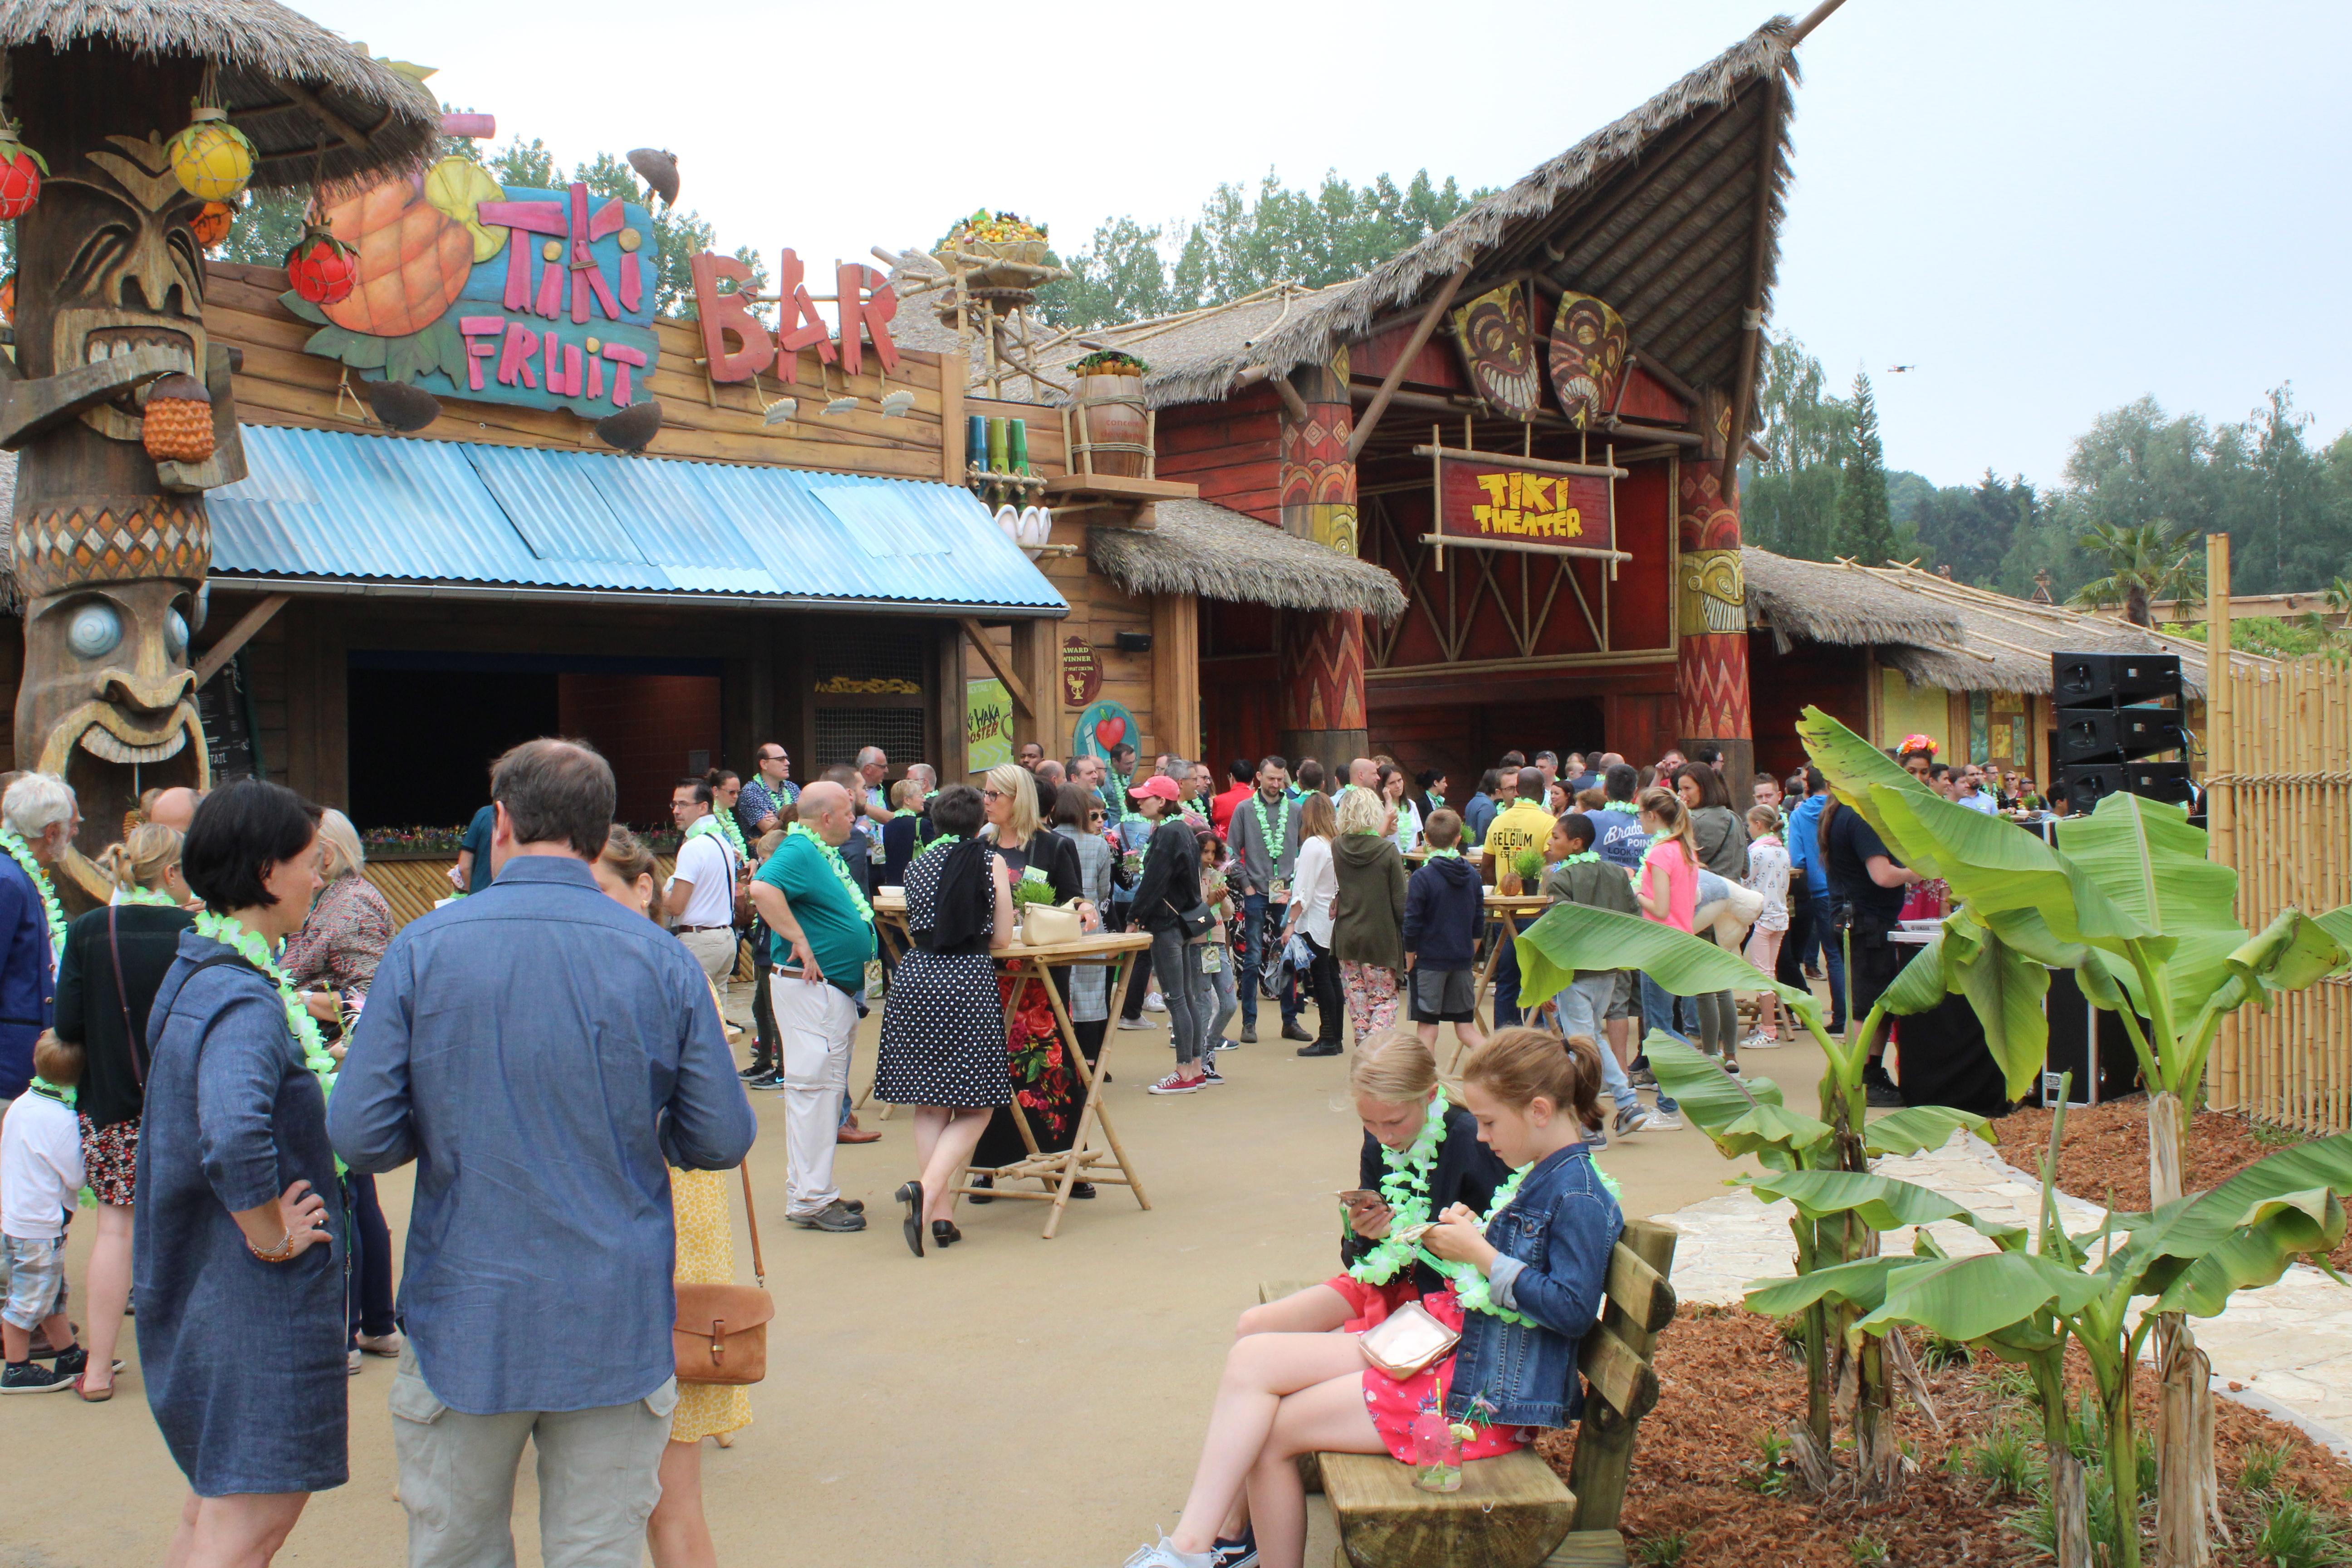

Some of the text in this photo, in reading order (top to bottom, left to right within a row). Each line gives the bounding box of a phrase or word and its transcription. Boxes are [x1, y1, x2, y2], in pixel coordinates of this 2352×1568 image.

[691, 247, 899, 385] BAR
[1476, 472, 1569, 513] TIKI
[1472, 505, 1583, 538] THEATER
[974, 704, 1000, 729] WAKA
[1494, 832, 1533, 847] BELGIUM
